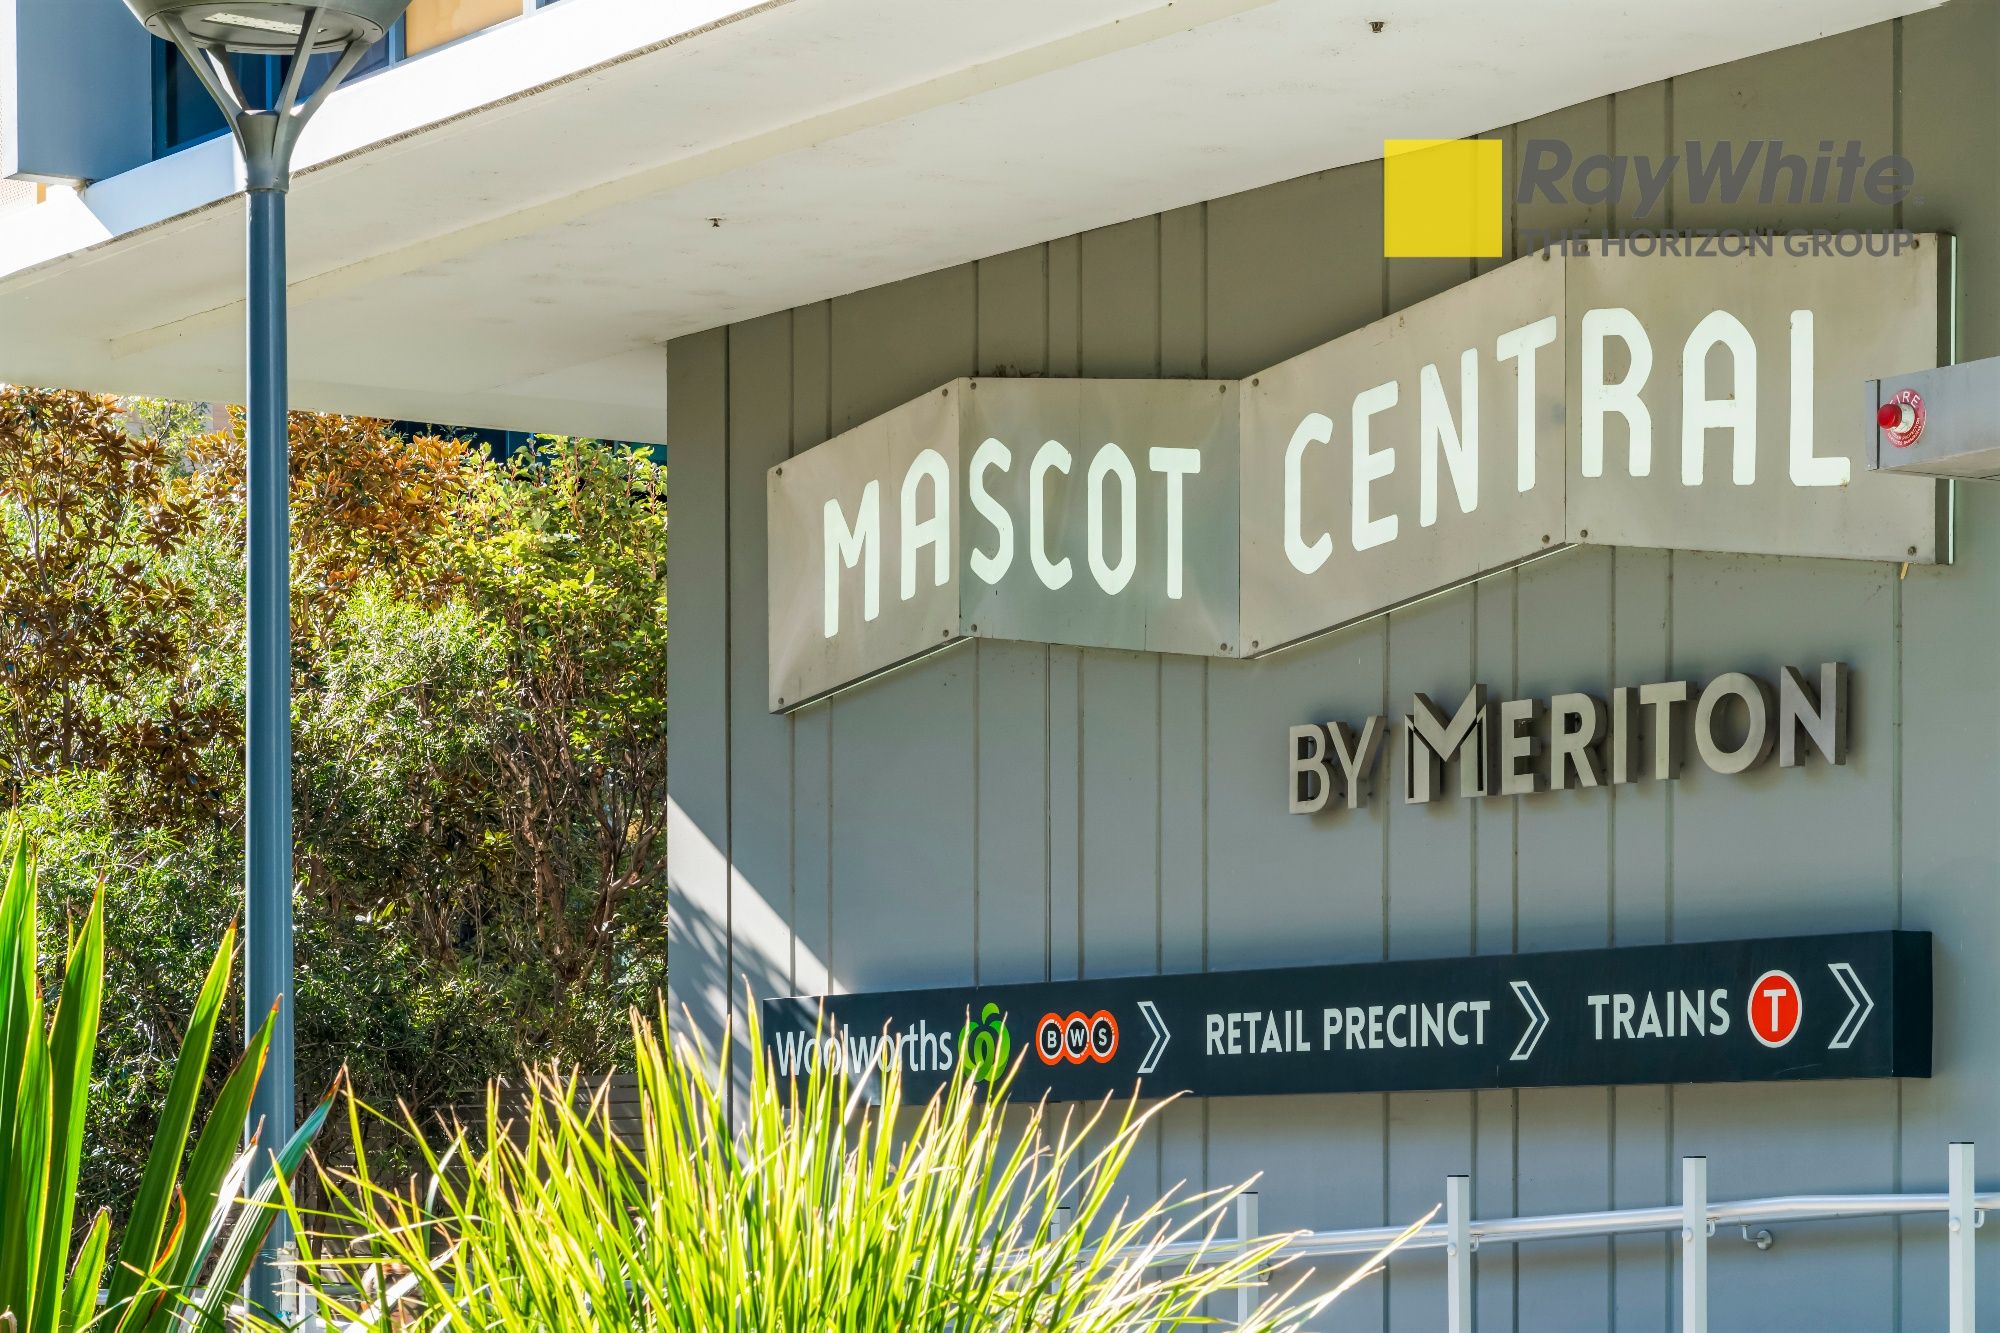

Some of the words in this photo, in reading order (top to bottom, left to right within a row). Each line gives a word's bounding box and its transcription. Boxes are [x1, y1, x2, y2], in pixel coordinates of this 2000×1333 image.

[823, 437, 1201, 639] MASCOT
[1284, 307, 1851, 575] CENTRAL
[1288, 715, 1386, 815] BY
[1404, 661, 1847, 805] MERITON
[1206, 1009, 1311, 1056] RETAIL
[1323, 1000, 1491, 1051] PRECINCT
[1588, 988, 1731, 1040] TRAINS
[1763, 988, 1787, 1033] T
[775, 1019, 954, 1077] Woolworths
